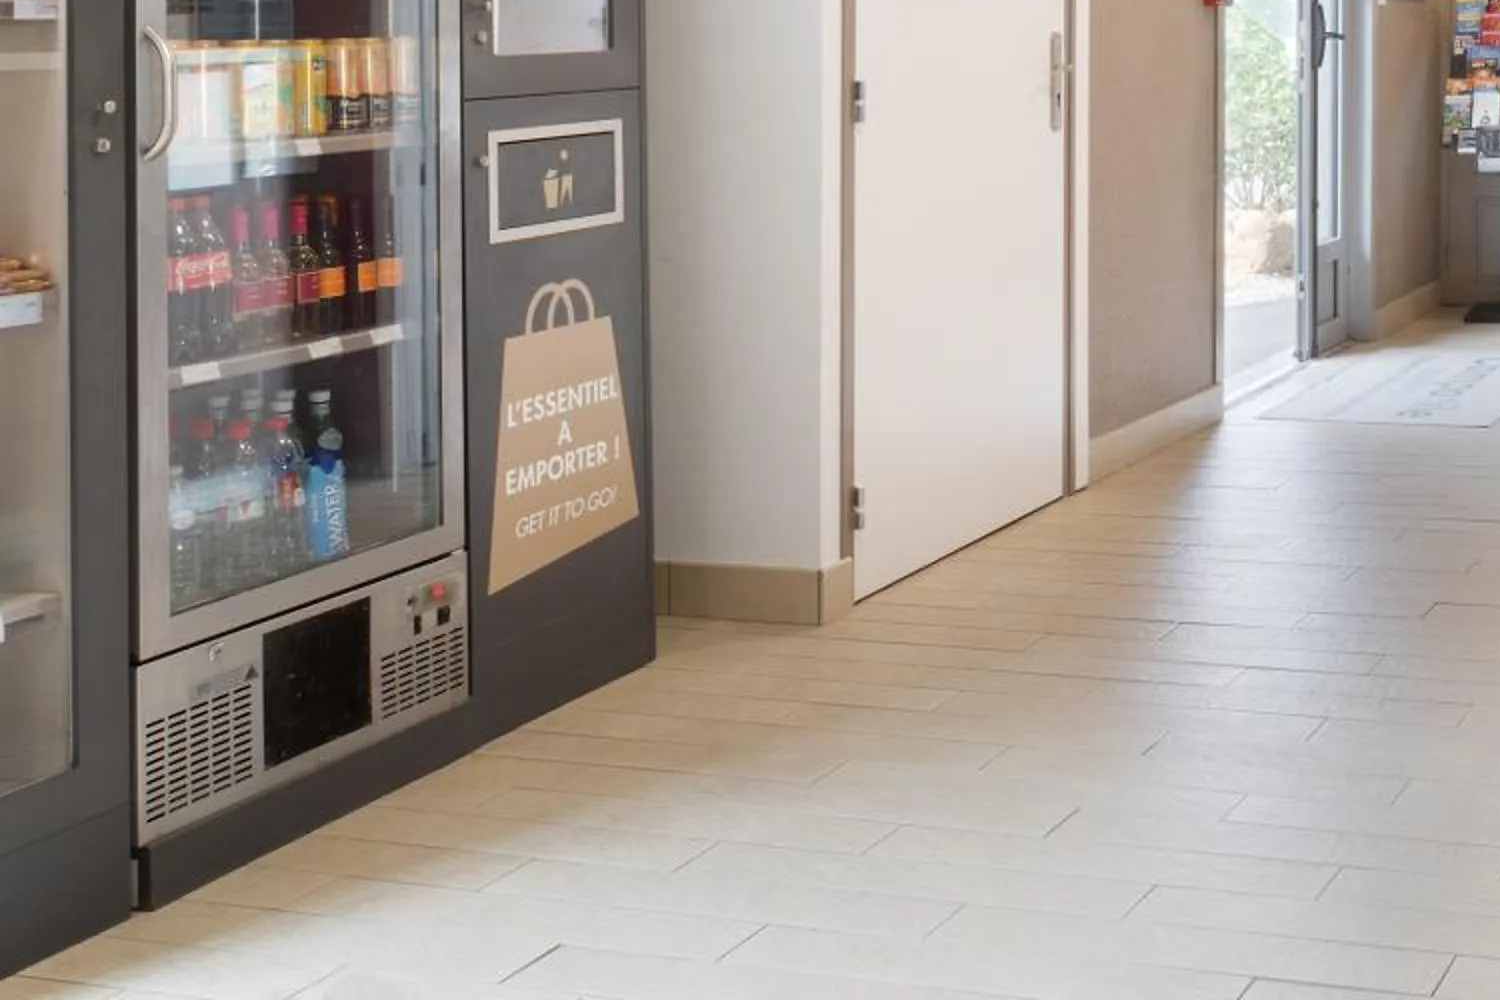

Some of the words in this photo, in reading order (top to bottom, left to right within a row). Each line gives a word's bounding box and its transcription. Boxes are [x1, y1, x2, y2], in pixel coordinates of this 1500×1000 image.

[507, 375, 618, 429] L'ESSENTIEL
[557, 420, 573, 446] A
[506, 440, 608, 496] EMPORTER
[614, 433, 620, 460] !
[515, 509, 545, 538] GET
[549, 504, 561, 527] IT
[565, 497, 584, 523] TO
